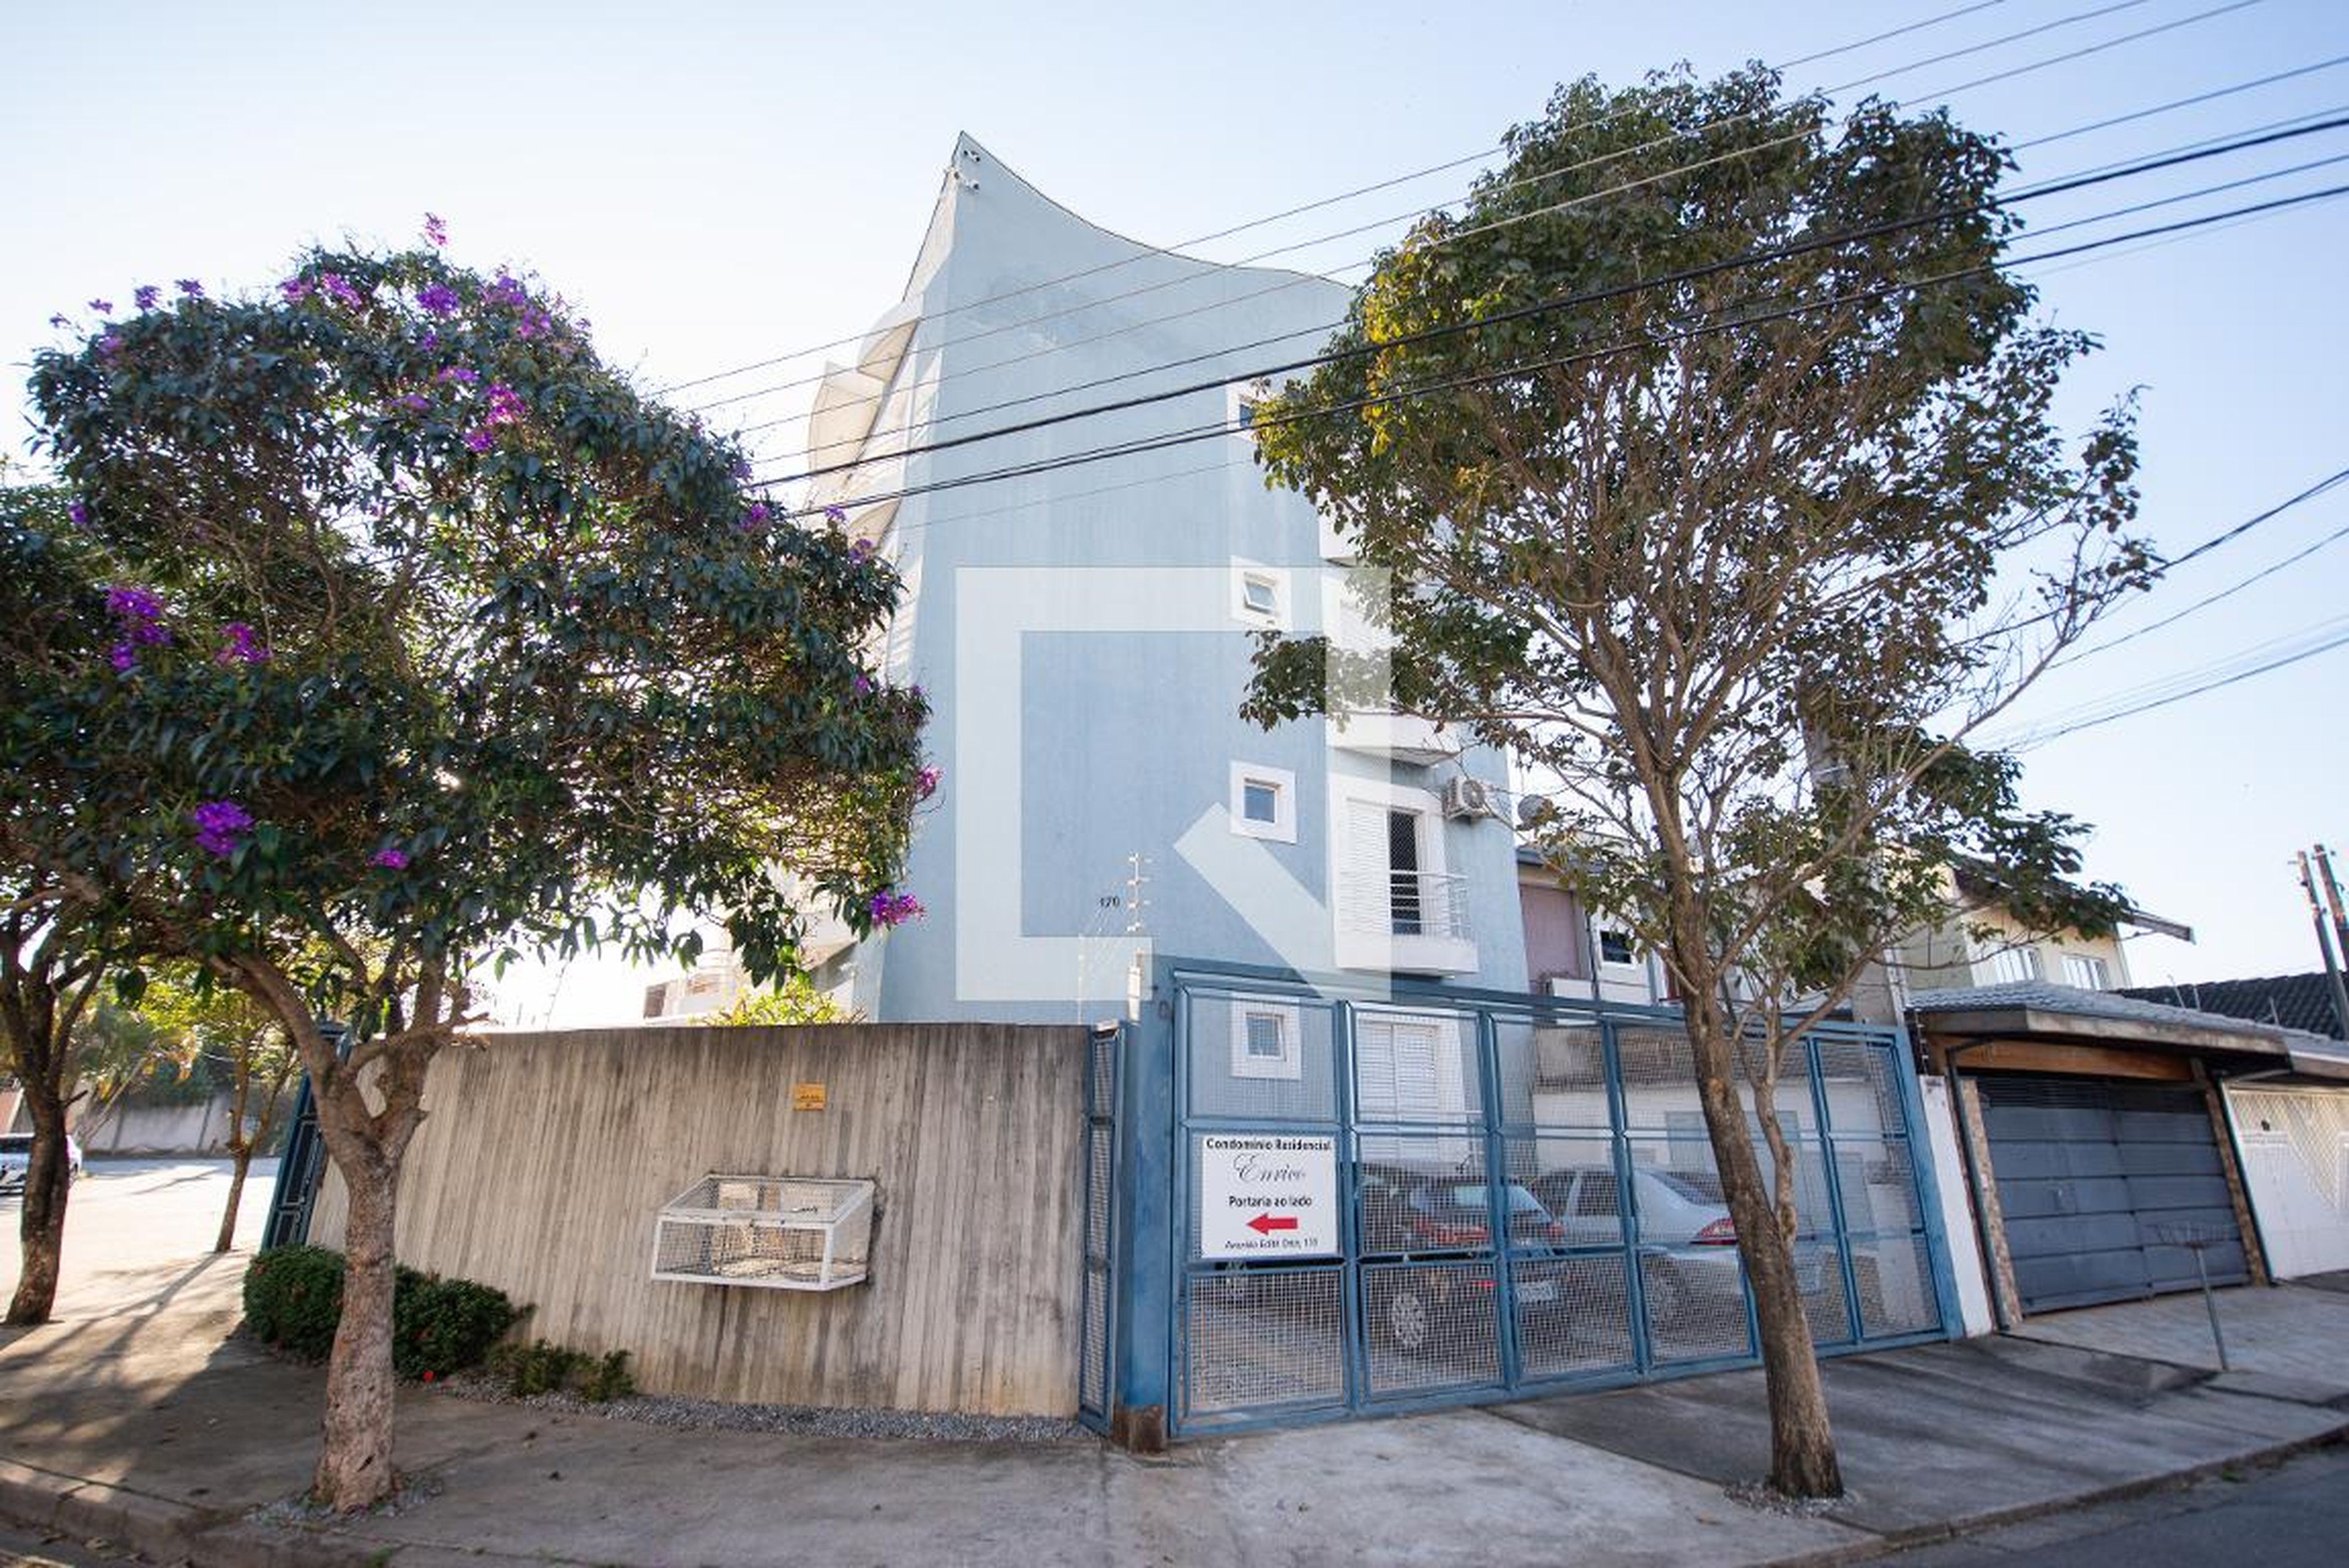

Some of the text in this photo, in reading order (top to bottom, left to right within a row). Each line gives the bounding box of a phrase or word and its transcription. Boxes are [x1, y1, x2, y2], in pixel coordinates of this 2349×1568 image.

[1276, 1138, 1330, 1151] Residencial
[1229, 1196, 1312, 1208] Portaria ao lado
